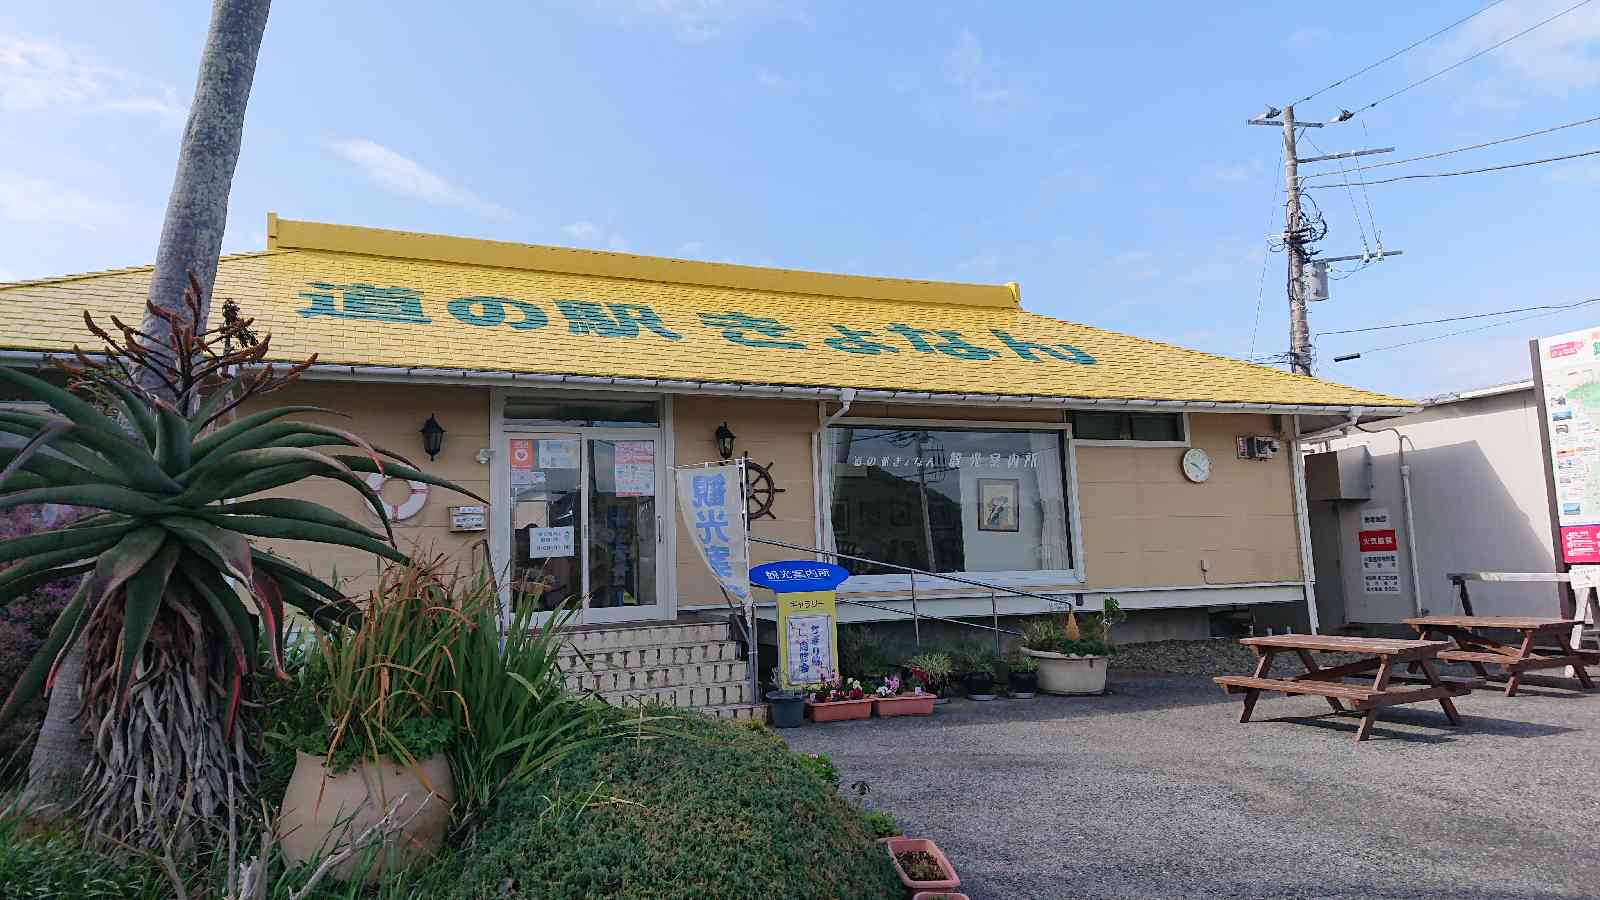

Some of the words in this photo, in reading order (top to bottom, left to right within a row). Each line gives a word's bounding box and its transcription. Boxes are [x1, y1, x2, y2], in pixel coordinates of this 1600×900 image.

[766, 568, 830, 580] 観光案内所
